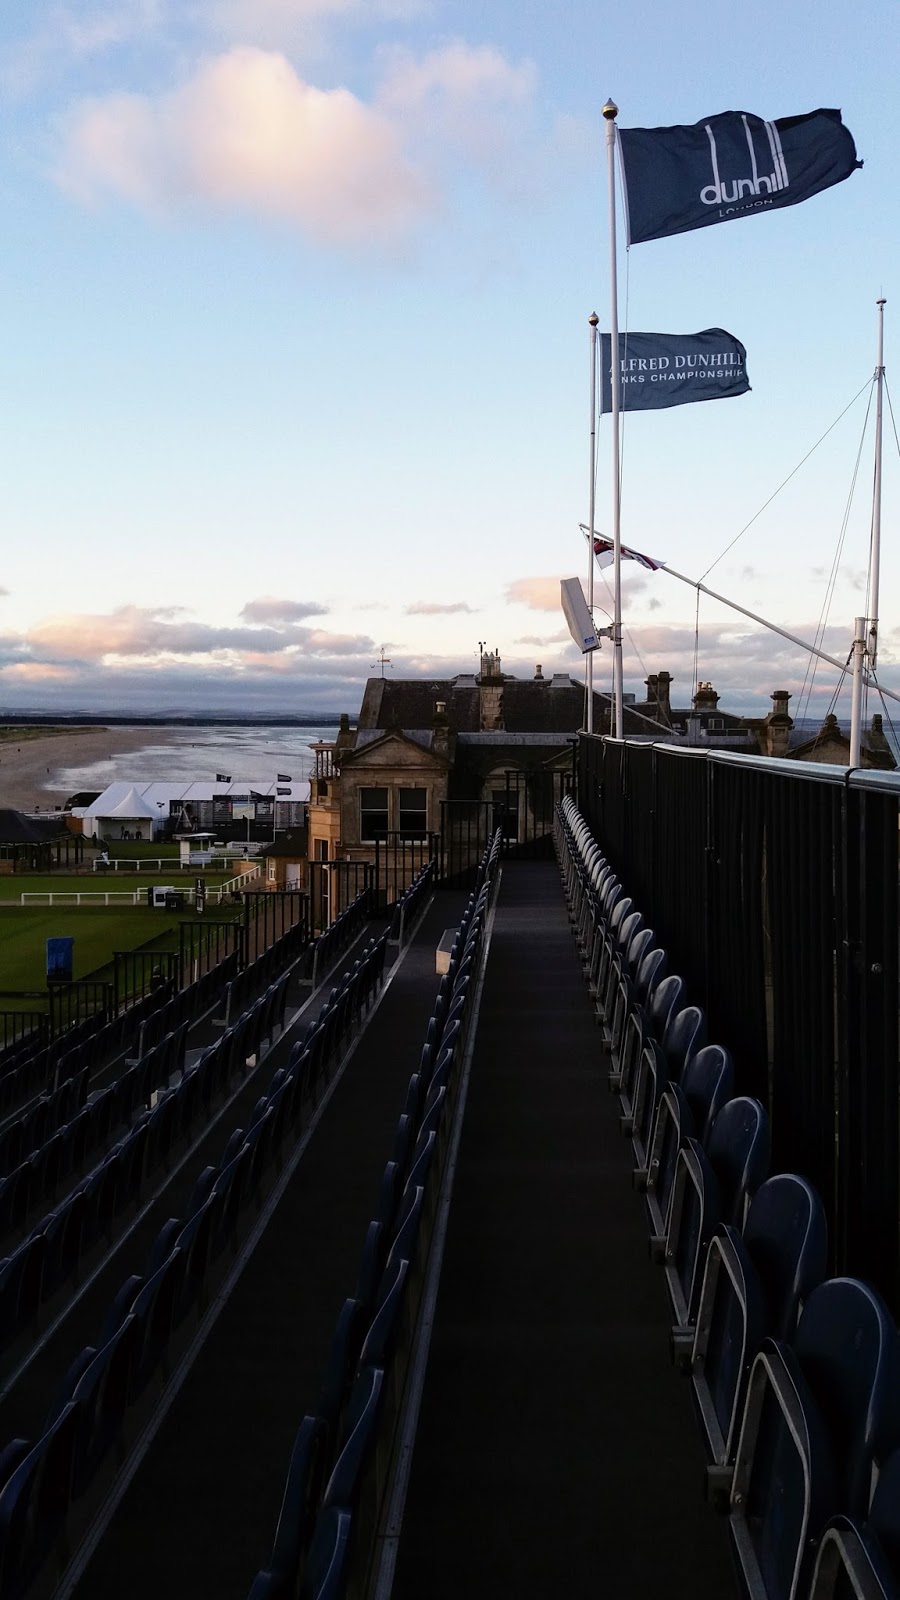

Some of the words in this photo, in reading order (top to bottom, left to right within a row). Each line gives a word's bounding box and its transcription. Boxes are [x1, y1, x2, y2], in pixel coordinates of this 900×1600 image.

[700, 115, 789, 205] dunhill
[719, 199, 773, 217] LOON
[609, 357, 670, 373] LFRED
[674, 352, 743, 369] DUNHILL
[610, 375, 645, 384] NKS
